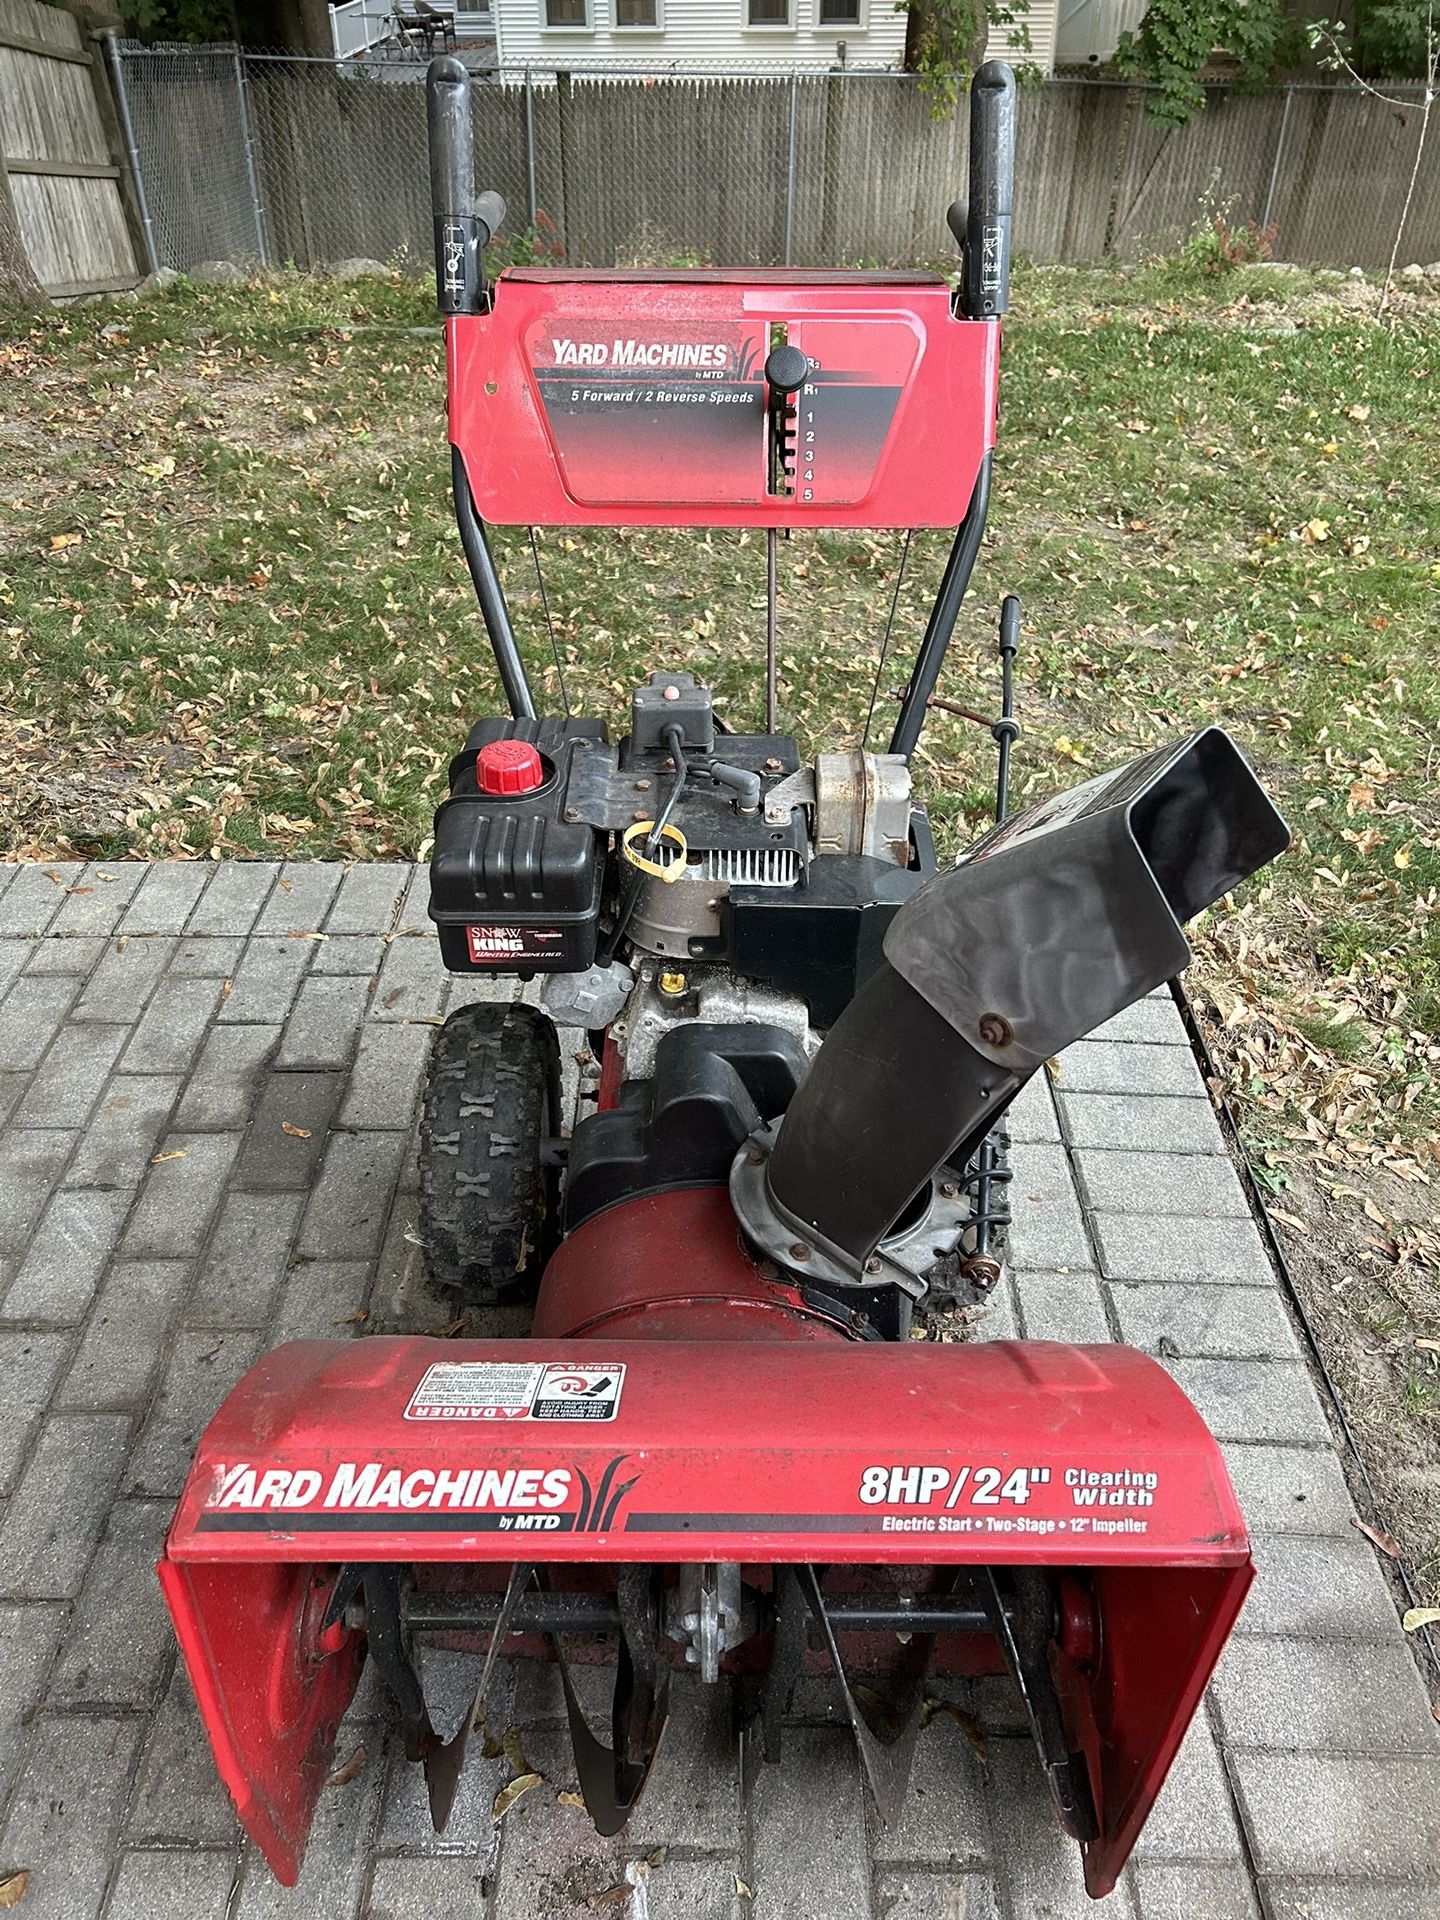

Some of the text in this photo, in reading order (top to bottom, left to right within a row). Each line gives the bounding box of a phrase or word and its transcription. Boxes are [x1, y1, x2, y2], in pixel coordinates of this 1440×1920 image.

[552, 339, 728, 366] YARD MACHINES
[572, 390, 754, 405] 5 Forward / 2 Reverse Speeds
[806, 412, 814, 423] 1
[806, 431, 815, 442] 2
[805, 450, 814, 462] 3
[804, 470, 814, 480] 4
[804, 489, 813, 500] 5
[473, 938, 524, 951] KING
[415, 1407, 497, 1416] DANGER
[1064, 1468, 1158, 1490] Clearing
[206, 1464, 572, 1508] YARD MACHINES
[1072, 1488, 1154, 1506] Width
[498, 1516, 560, 1530] by MTD
[882, 1516, 1148, 1534] Electric Start Two-Stage 12" Impeller
